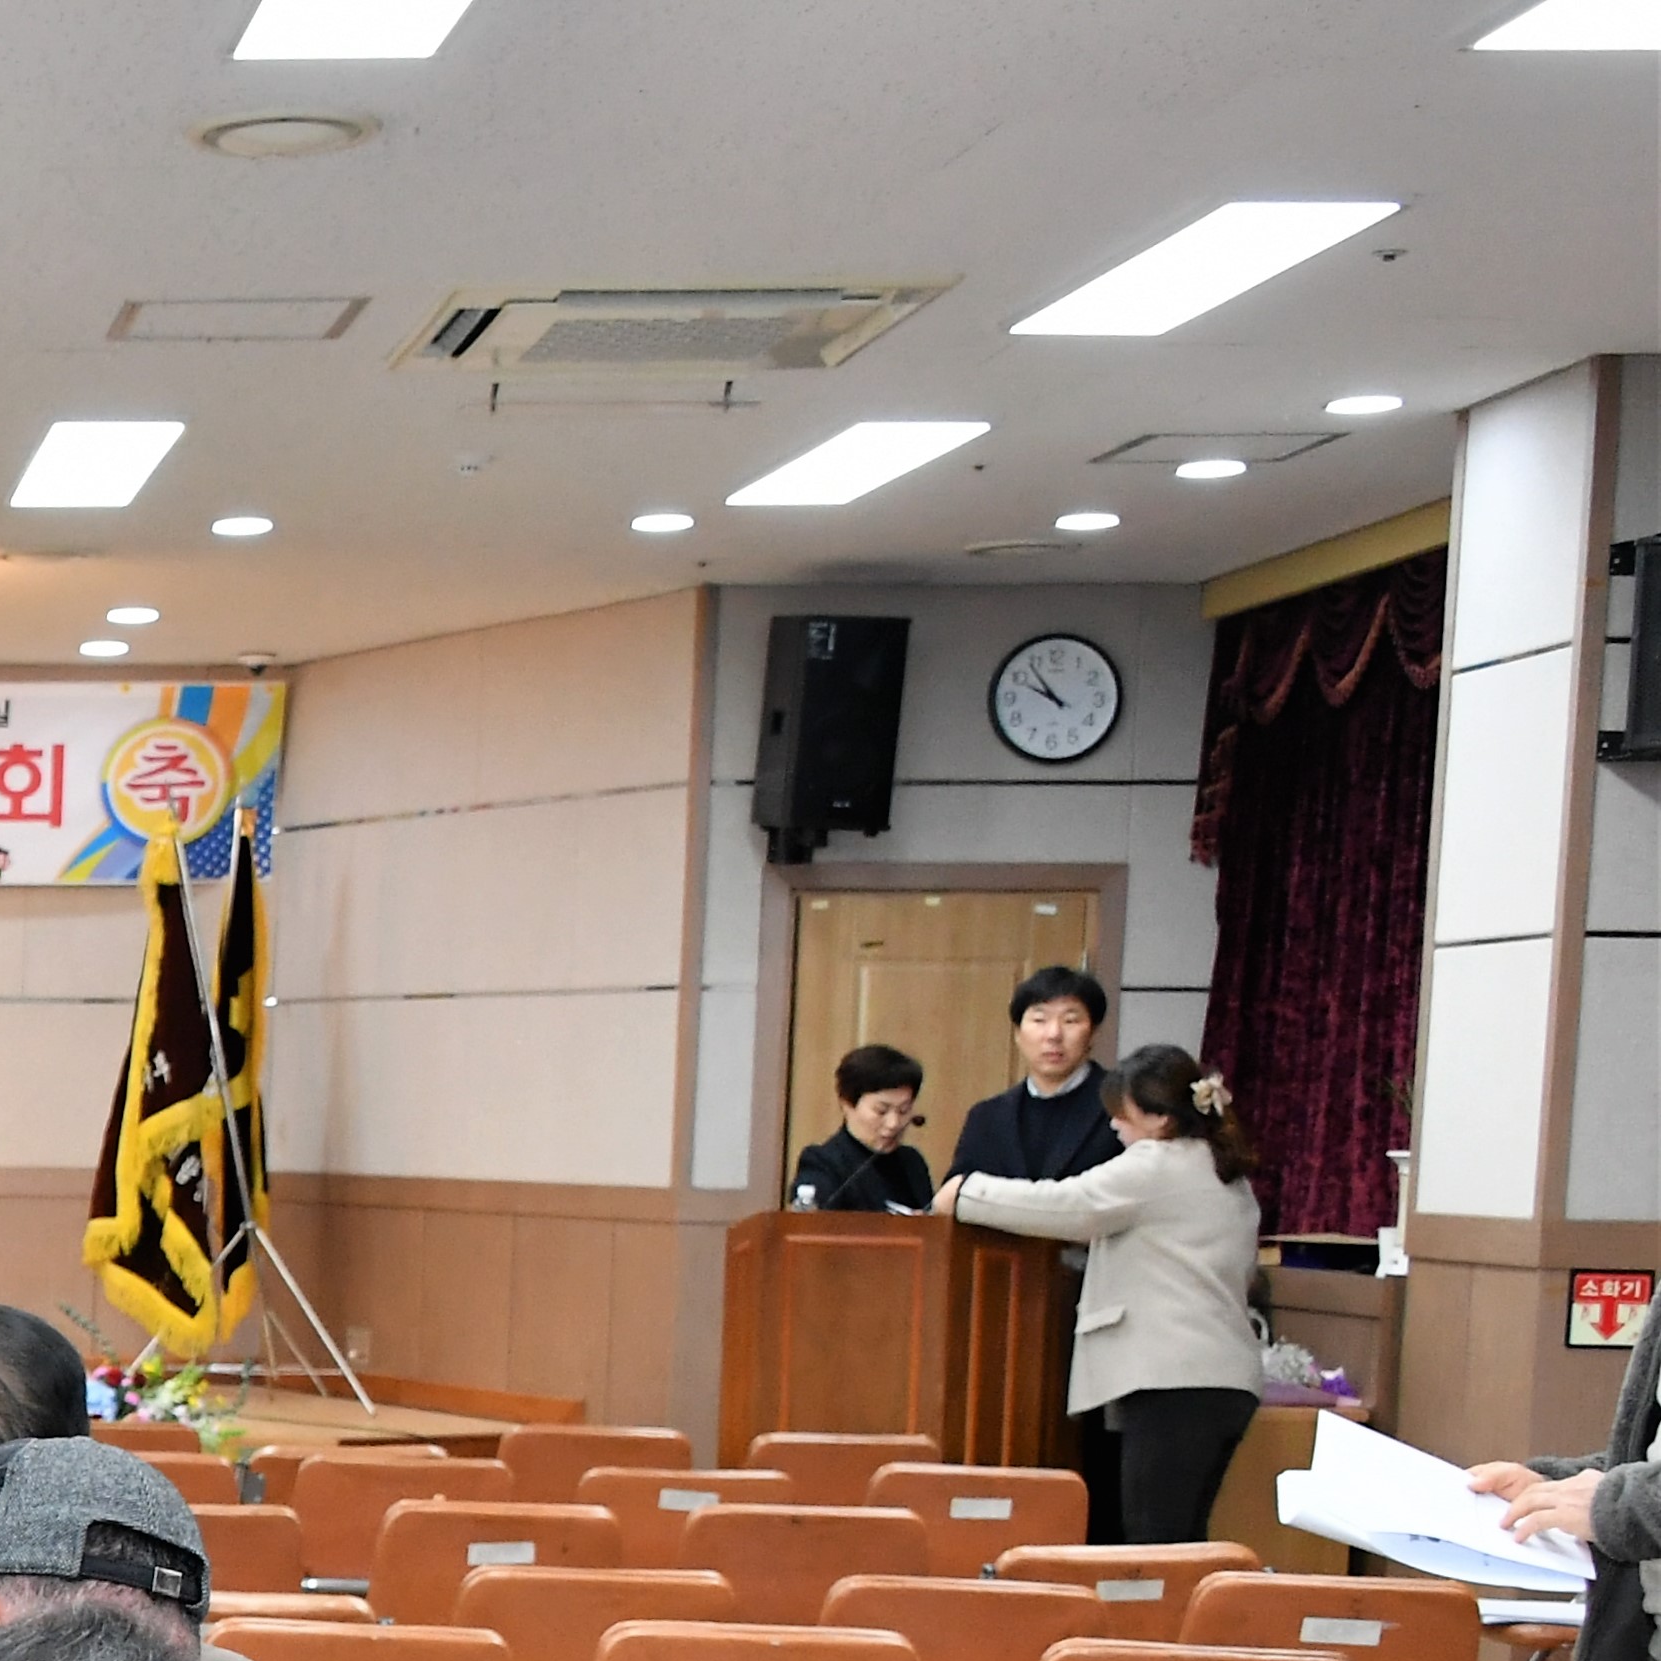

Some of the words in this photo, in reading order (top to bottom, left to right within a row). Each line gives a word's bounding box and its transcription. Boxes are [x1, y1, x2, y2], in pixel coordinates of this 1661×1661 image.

[1087, 671, 1099, 686] 2
[1004, 692, 1017, 707] 9
[1094, 692, 1106, 708] 3
[1010, 711, 1022, 728] 8
[1082, 712, 1095, 727] 4
[1028, 728, 1038, 742] 7
[1046, 733, 1058, 750] 6
[1067, 728, 1078, 745] 5
[124, 742, 205, 823] 축
[1579, 1279, 1642, 1298] 소화기
